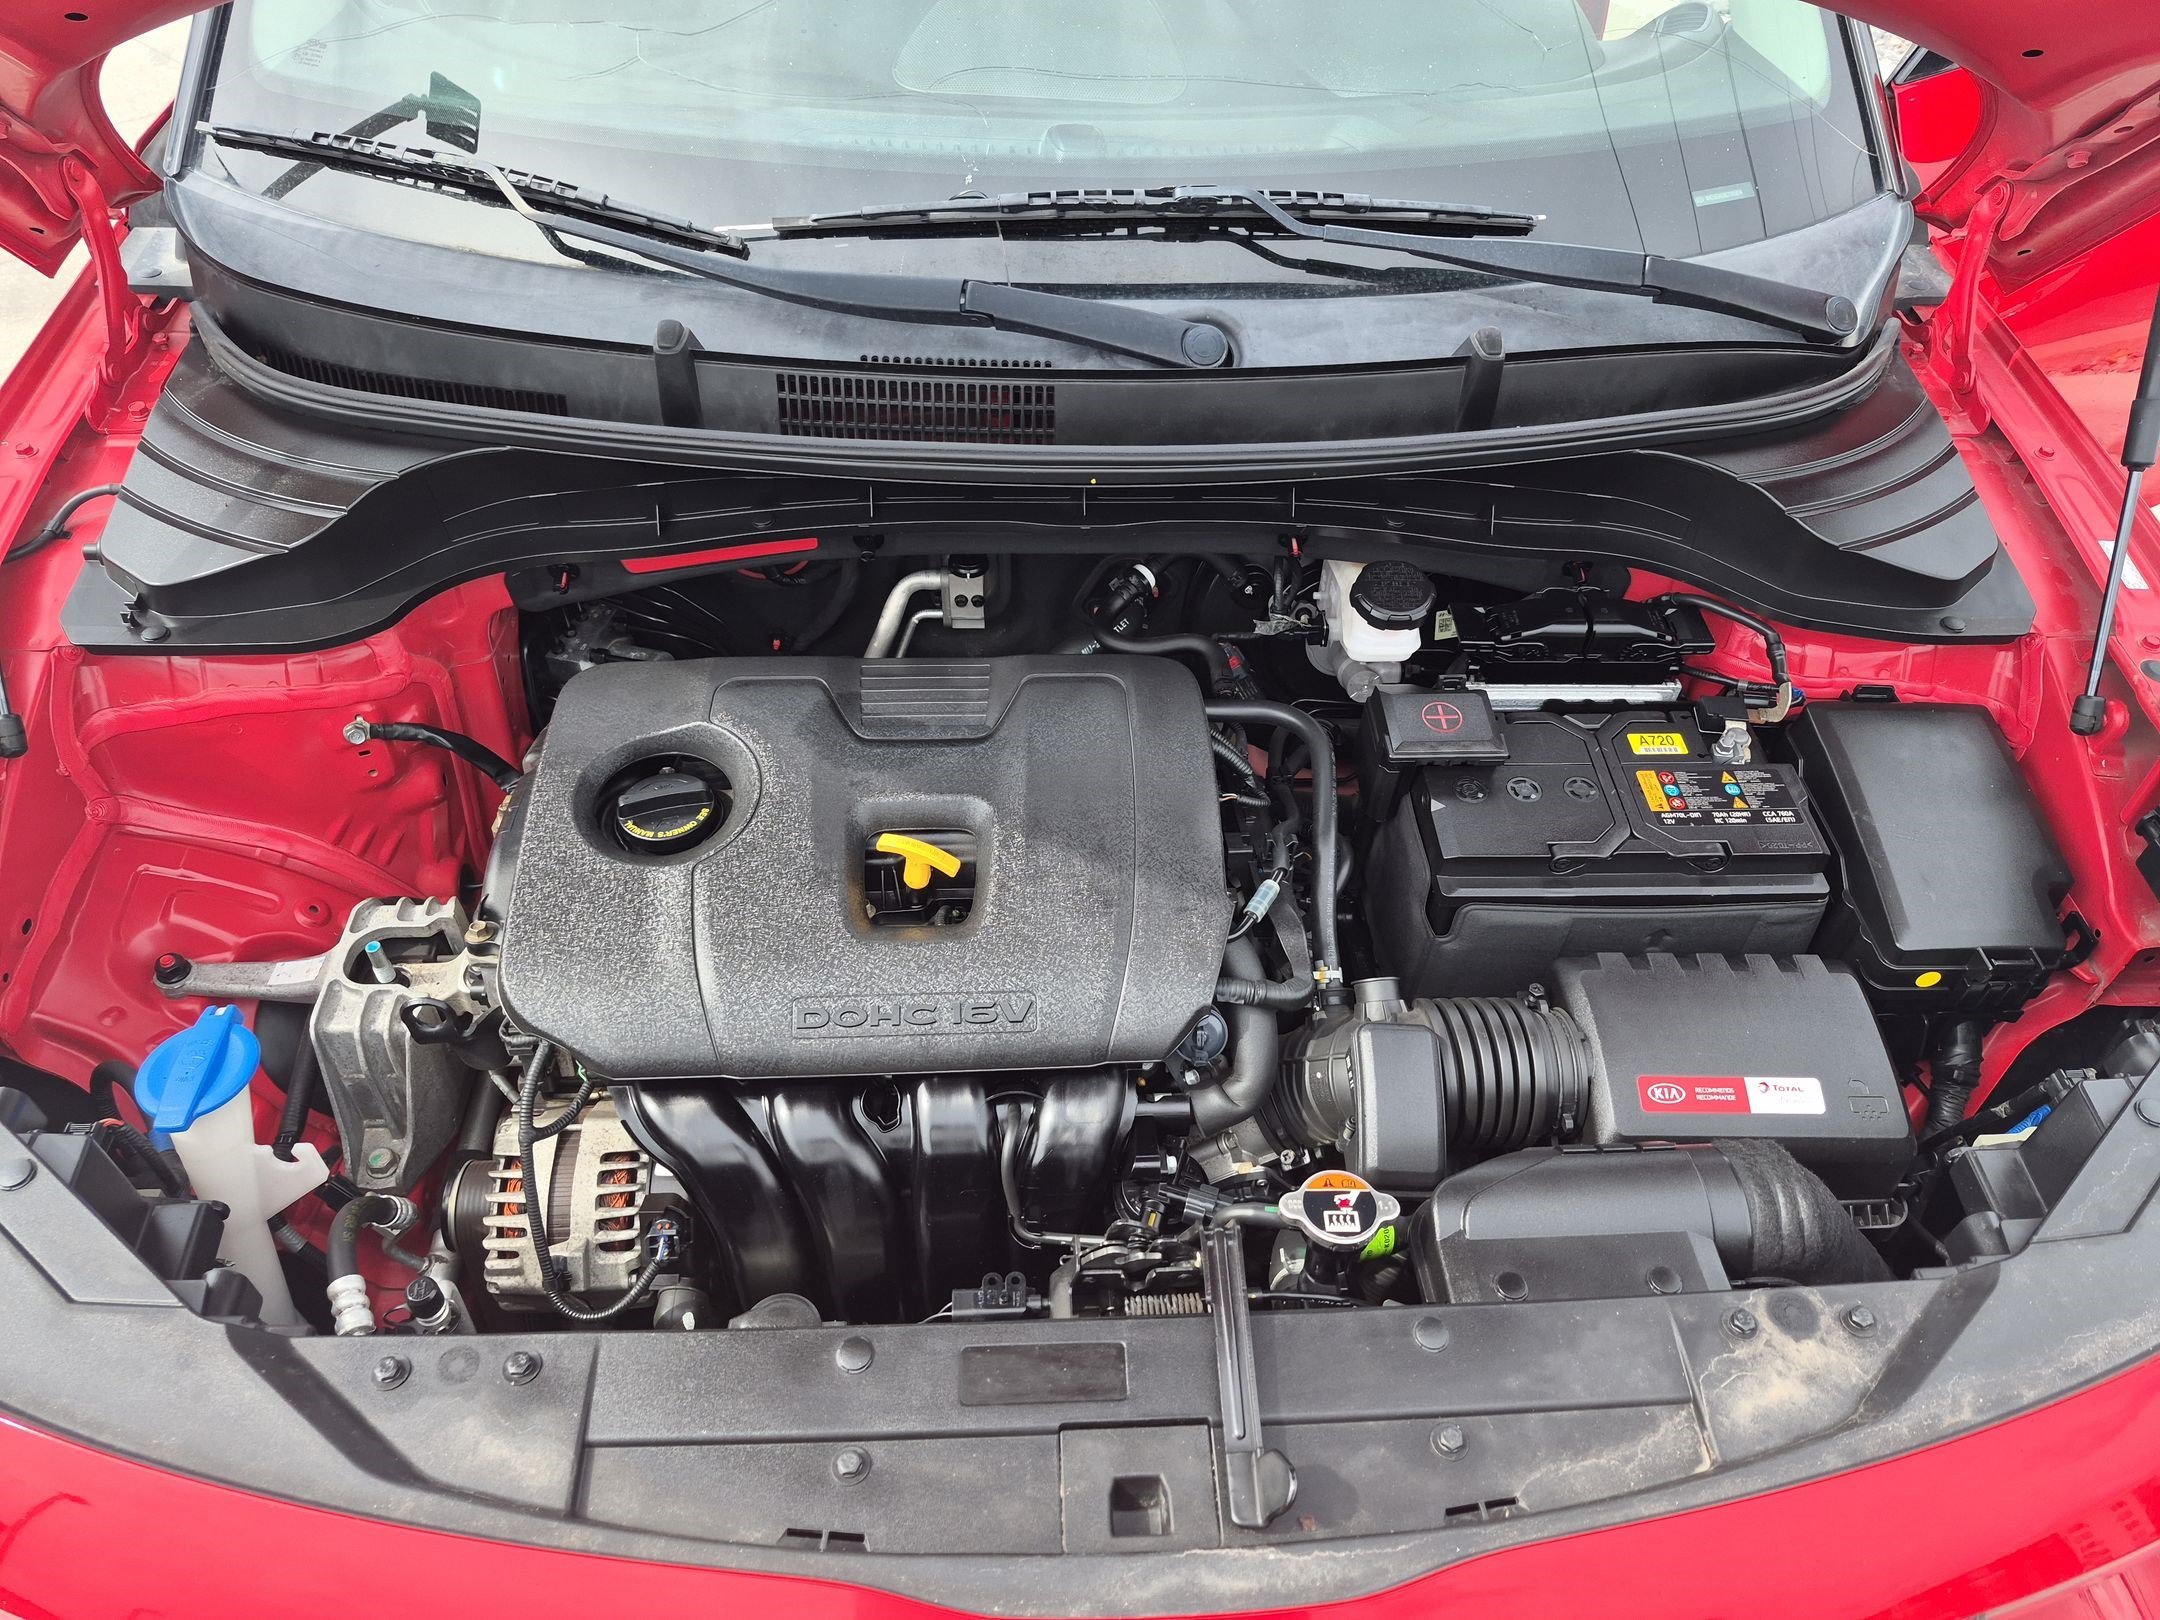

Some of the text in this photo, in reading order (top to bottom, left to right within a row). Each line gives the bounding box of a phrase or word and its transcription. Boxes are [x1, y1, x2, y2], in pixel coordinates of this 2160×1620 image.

[1640, 735, 1674, 746] A720
[624, 807, 710, 838] SEE OWNER'S MANUAL
[796, 1000, 1034, 1030] DOHC 16V
[1653, 1087, 1680, 1099] KIA
